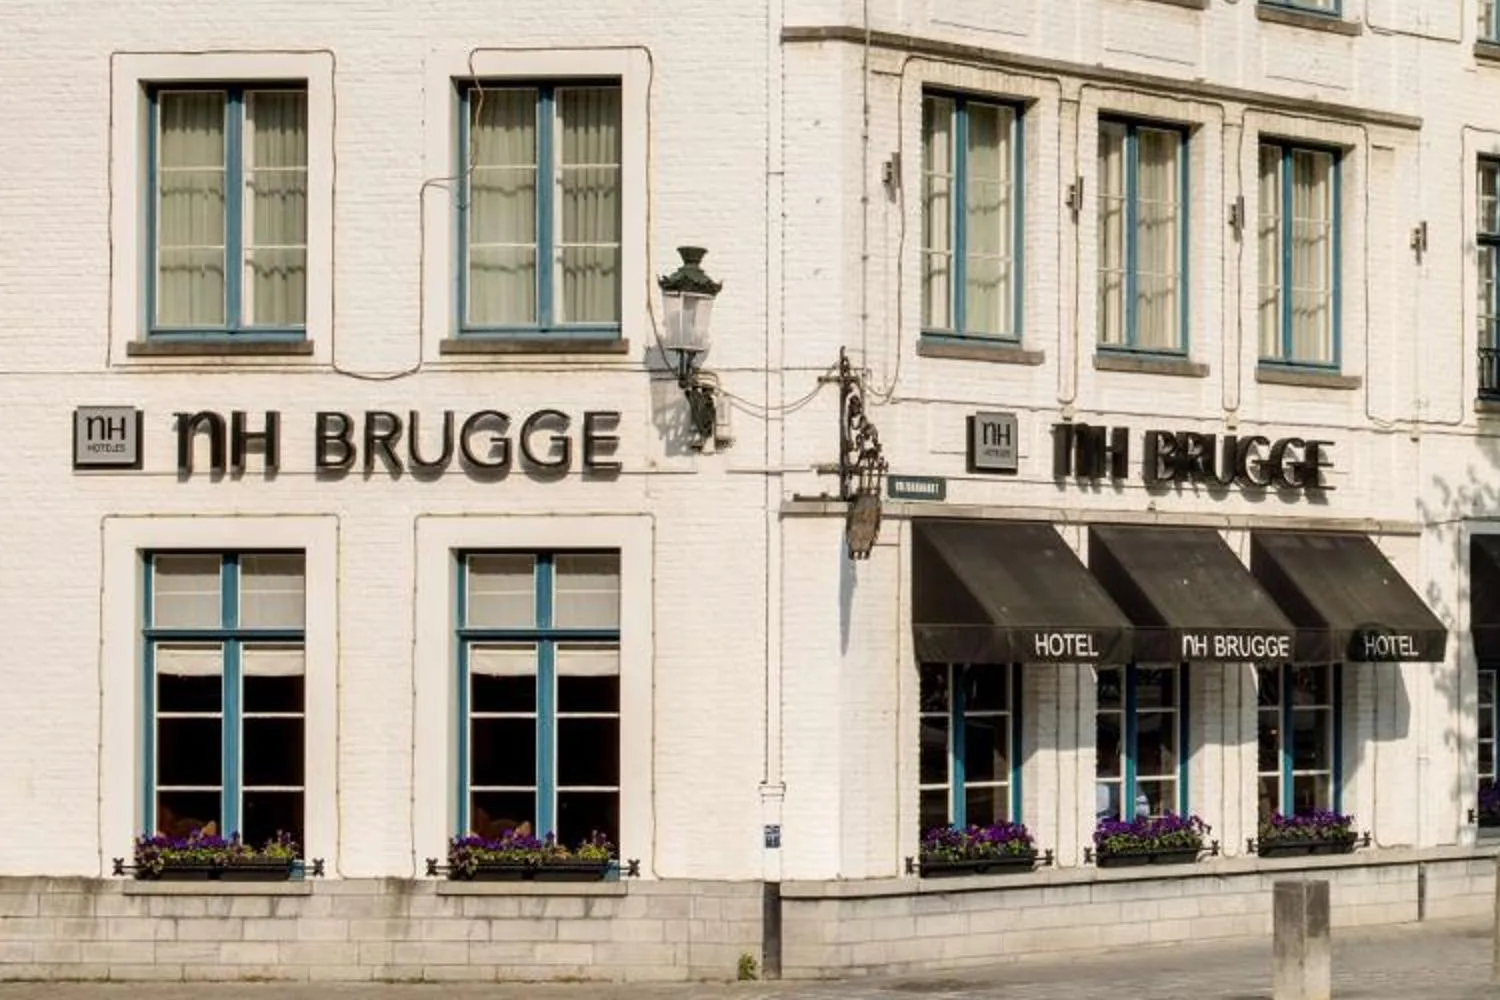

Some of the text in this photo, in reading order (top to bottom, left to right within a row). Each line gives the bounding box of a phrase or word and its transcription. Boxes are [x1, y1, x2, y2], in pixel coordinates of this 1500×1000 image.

[315, 409, 624, 473] BRUGGE
[1144, 429, 1337, 492] BRUGGE
[1035, 633, 1099, 657] HOTEL
[1214, 634, 1290, 658] BRUGGE
[1363, 634, 1420, 657] HOTEL
